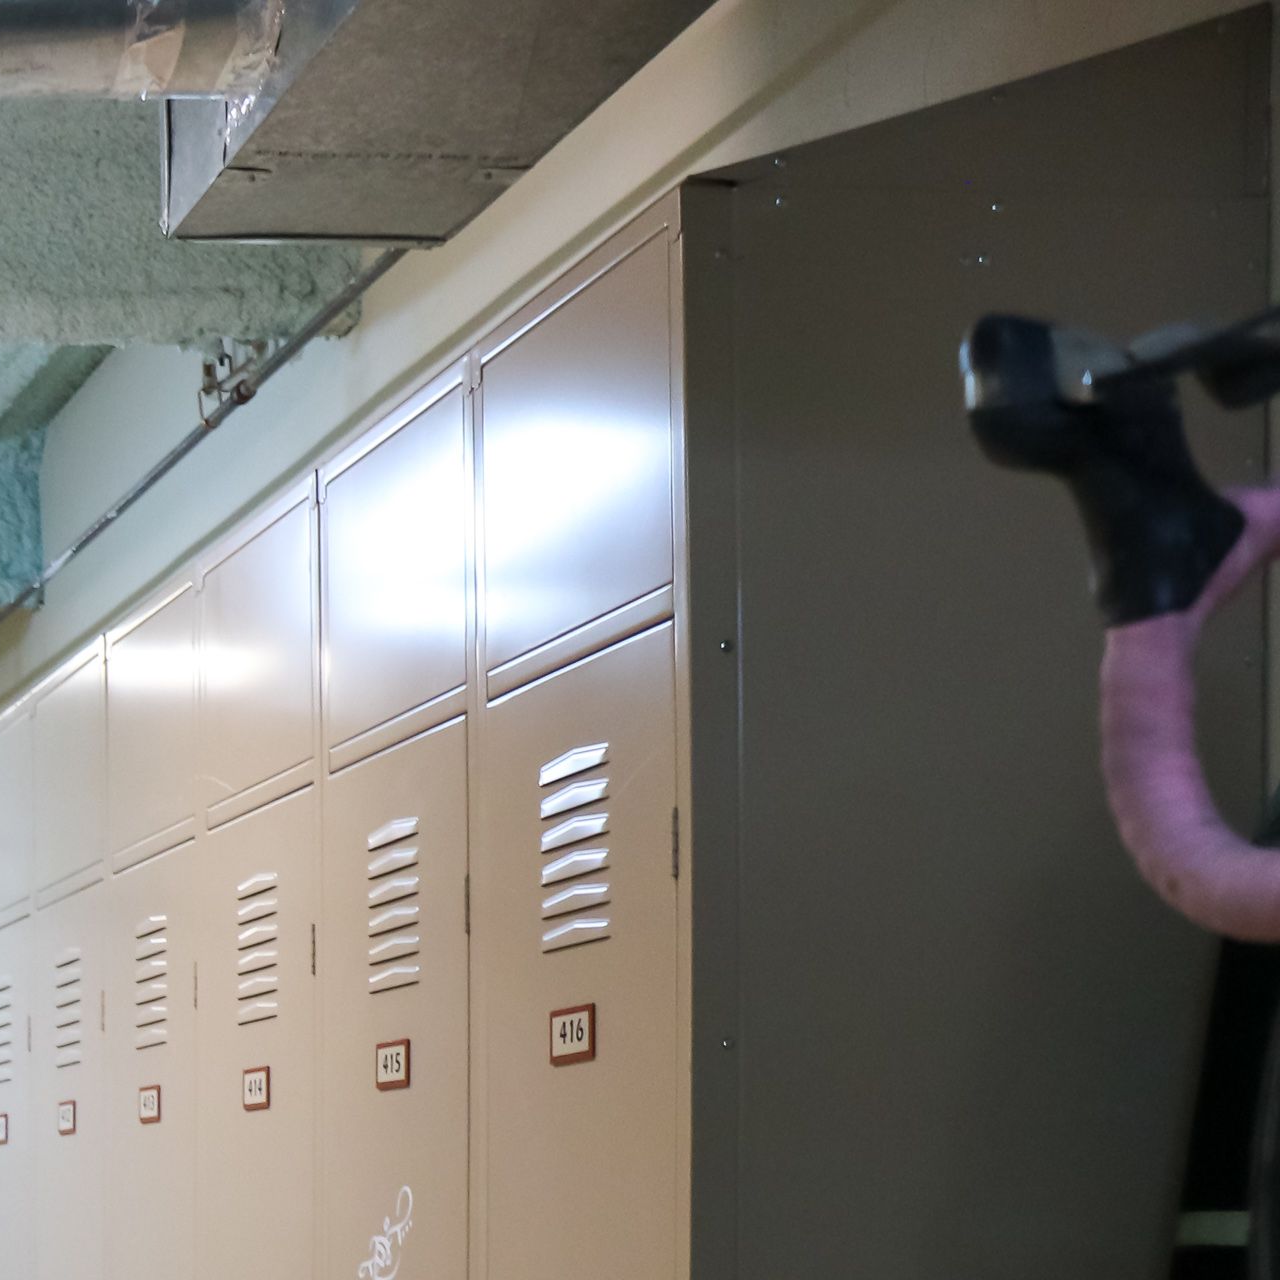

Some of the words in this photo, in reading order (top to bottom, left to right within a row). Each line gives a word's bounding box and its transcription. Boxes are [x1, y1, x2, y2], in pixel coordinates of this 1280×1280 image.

[559, 1017, 584, 1045] 416
[382, 1052, 401, 1075] 415
[248, 1077, 263, 1097] 414
